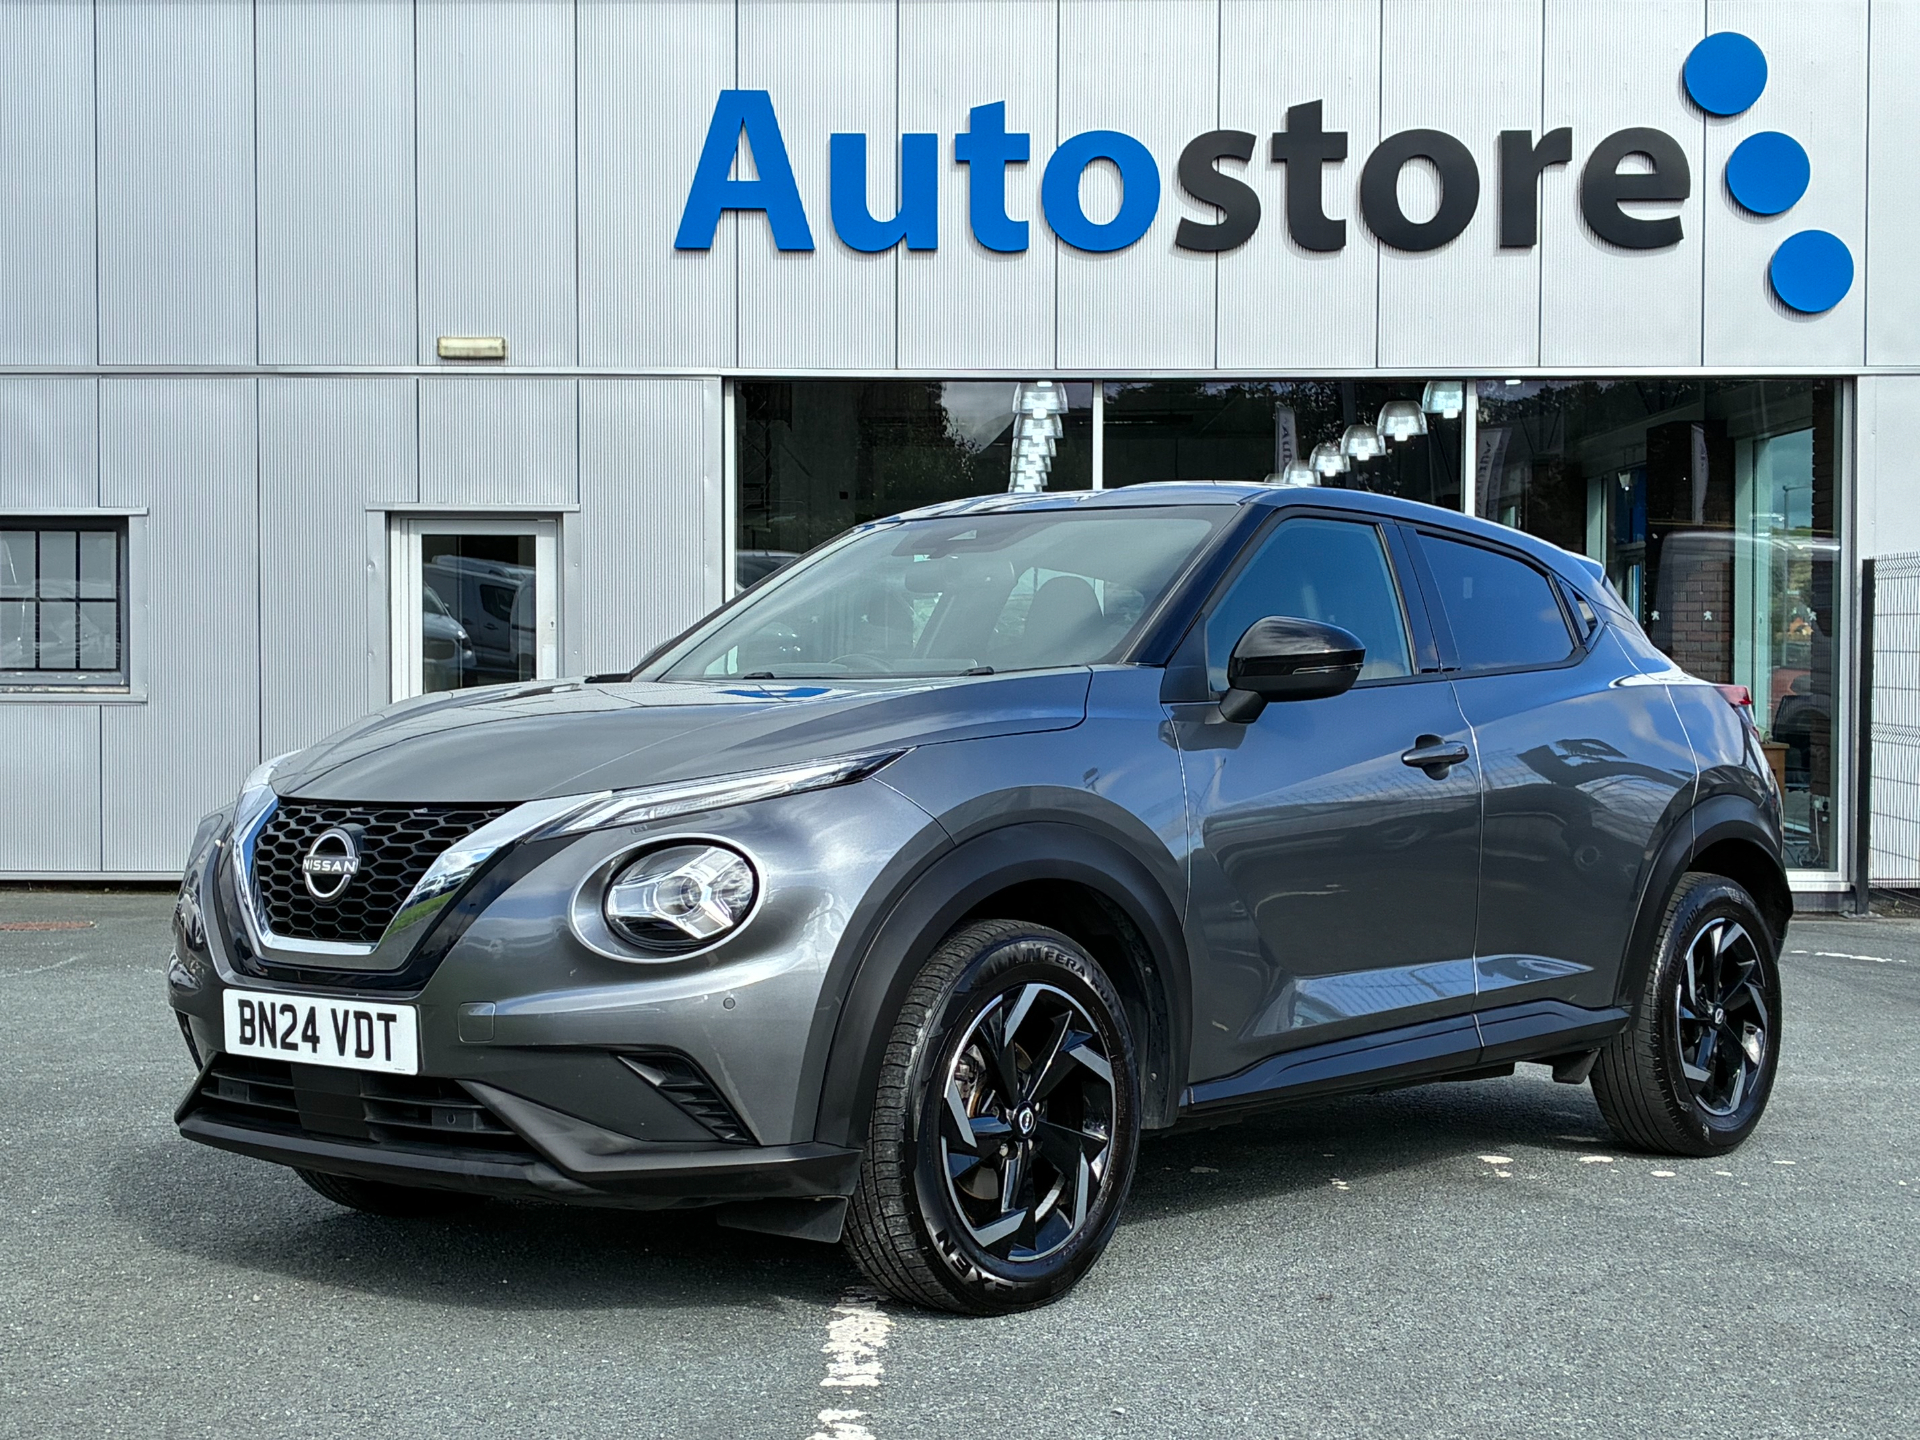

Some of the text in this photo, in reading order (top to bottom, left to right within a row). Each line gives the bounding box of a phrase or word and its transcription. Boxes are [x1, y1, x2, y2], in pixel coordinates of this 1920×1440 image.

[674, 89, 1691, 253] Autostore
[302, 858, 356, 872] NISSAN
[237, 998, 397, 1062] BN24 VDT
